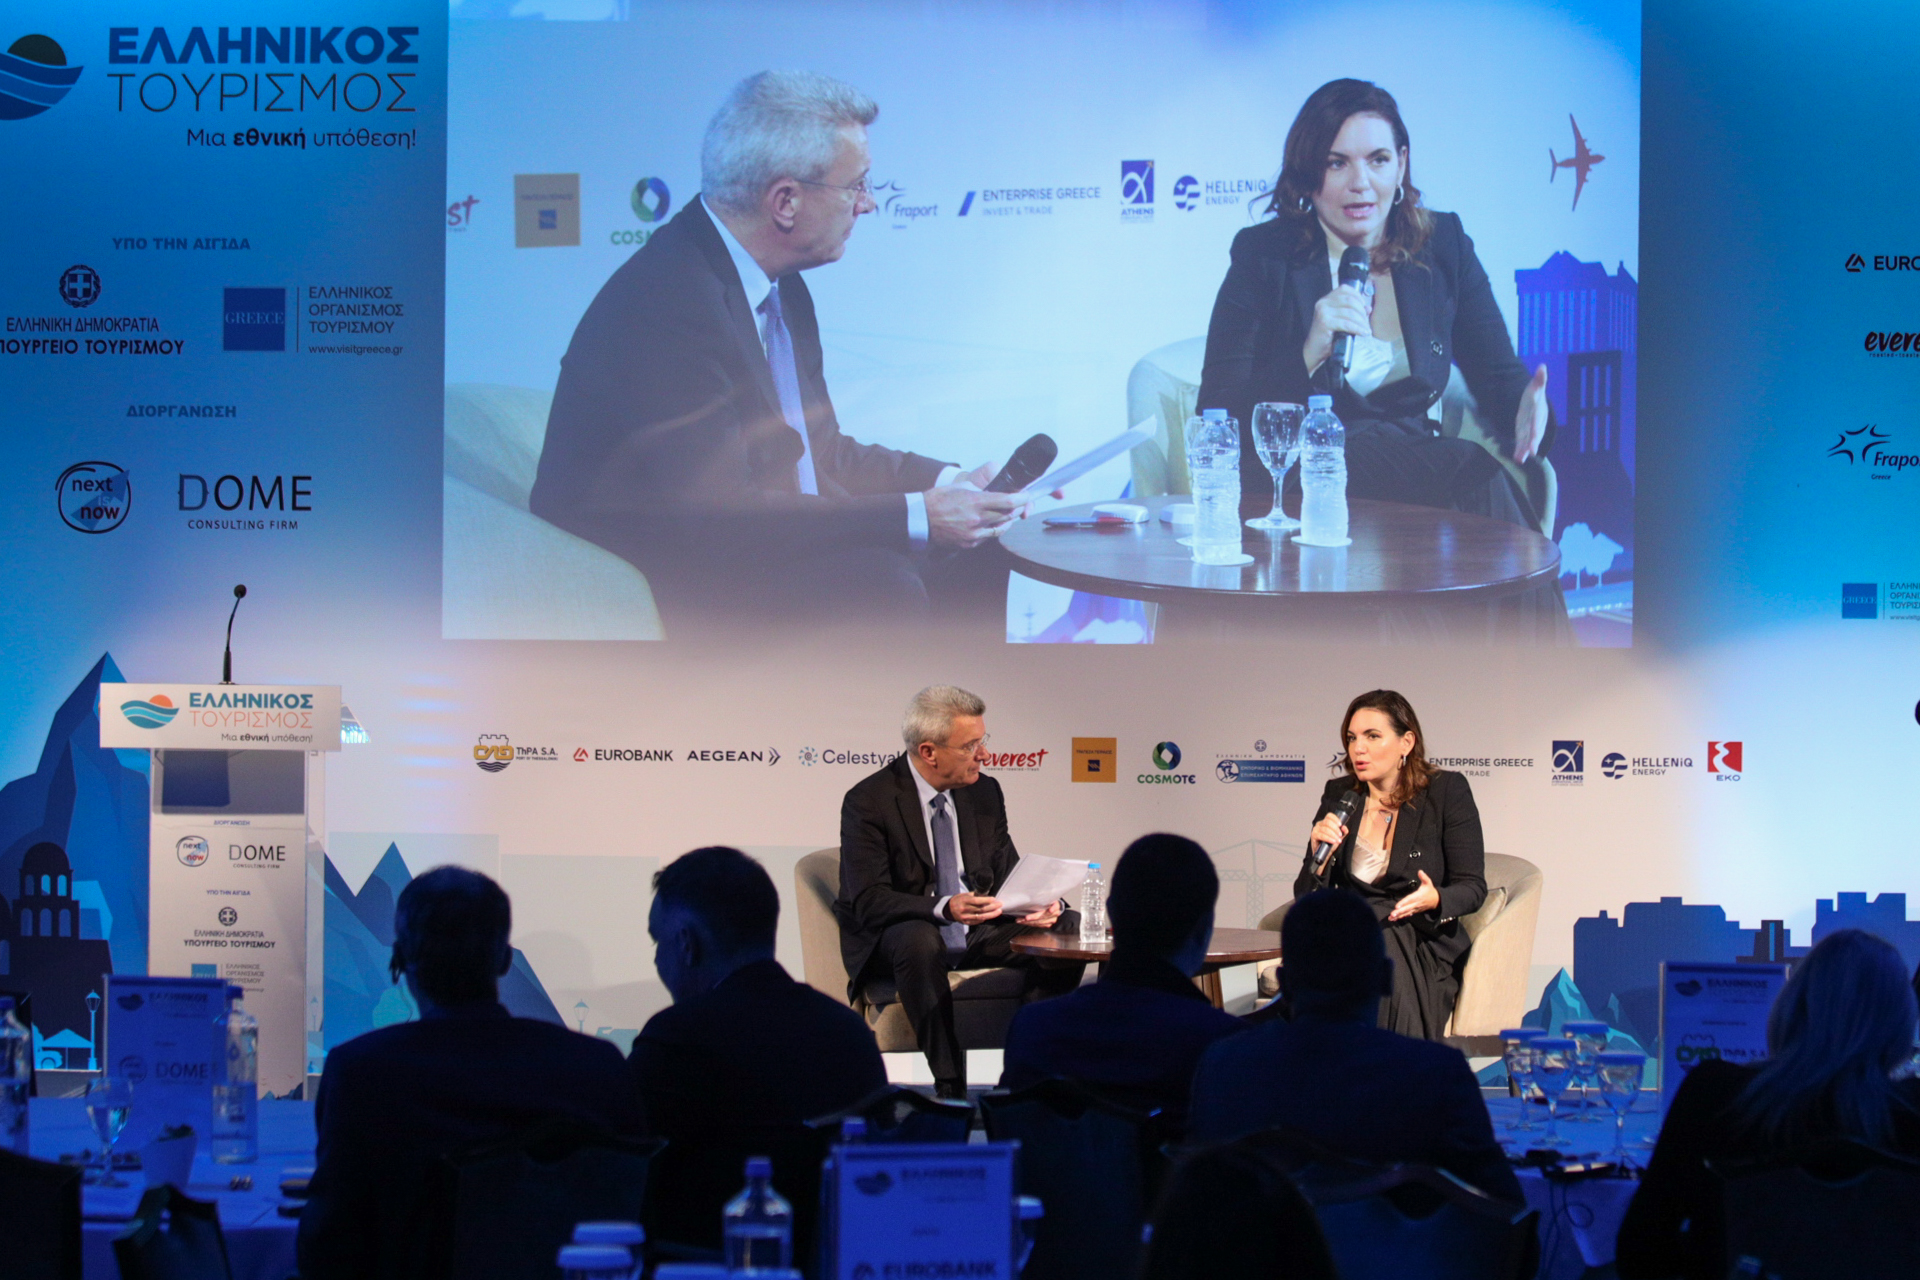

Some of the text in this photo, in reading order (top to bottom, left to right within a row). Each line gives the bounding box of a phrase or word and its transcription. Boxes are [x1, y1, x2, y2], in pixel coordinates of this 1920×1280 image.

[108, 26, 419, 64] ΕΛΛΗΝΙΚΟΣ
[107, 73, 416, 112] ΤΟΥΡΙΣΜΟΣ
[187, 128, 417, 150] Μια εθνική υπόθεση!
[983, 187, 1101, 201] ENTERPRISE GREECE
[1205, 196, 1240, 205] ENERGY
[894, 203, 938, 221] Fraport
[1025, 206, 1053, 216] TRADE
[1121, 207, 1155, 216] ATHENS
[113, 238, 251, 250] ΥΠΟ ΤΗΝ ΑΙΓΙΔΑ
[309, 286, 393, 299] ΕΛΛΗΝΙΚΟΣ
[309, 304, 404, 316] ΟΡΓΑΝΙΣΜΟΣ
[7, 316, 160, 332] ΕΛΛΗΝΙΚΗ ΔΗΜΟΚΡΑΤΙΑ
[225, 312, 284, 325] GREECE
[309, 321, 394, 334] ΤΟΥΡΙΣΜΟΥ
[85, 339, 184, 355] ΤΟΥΡΙΣΜΟΥ
[308, 345, 404, 357] www.visitgreece.gr
[126, 405, 237, 418] ΔΙΟΡΓΑΝΩΣΗ
[72, 478, 113, 492] next
[178, 473, 312, 511] DOME
[81, 506, 120, 519] now
[188, 520, 298, 530] CONSULTING FIRM
[189, 693, 313, 709] ΕΛΛΗΝΙΚΟΣ
[189, 711, 313, 729] ΤΟΥΡΙΣΜΟΣ
[240, 734, 269, 743] εθνική
[272, 734, 313, 743] υπόθεση!
[517, 747, 558, 755] ThPA S.A.
[595, 750, 674, 761] EUROBANK
[687, 750, 763, 761] AEGEAN
[1429, 758, 1534, 767] ENTERPRISE GREECE
[1632, 758, 1693, 768] HELLENiQ
[1137, 774, 1196, 784] COSMOTE
[1716, 774, 1741, 782] EKO
[228, 844, 286, 861] DOME
[184, 940, 276, 949] ΥΠΟΥΡΓΕΙΟ ΤΟΥΡΙΣΜΟΥ
[155, 1062, 208, 1079] DOME
